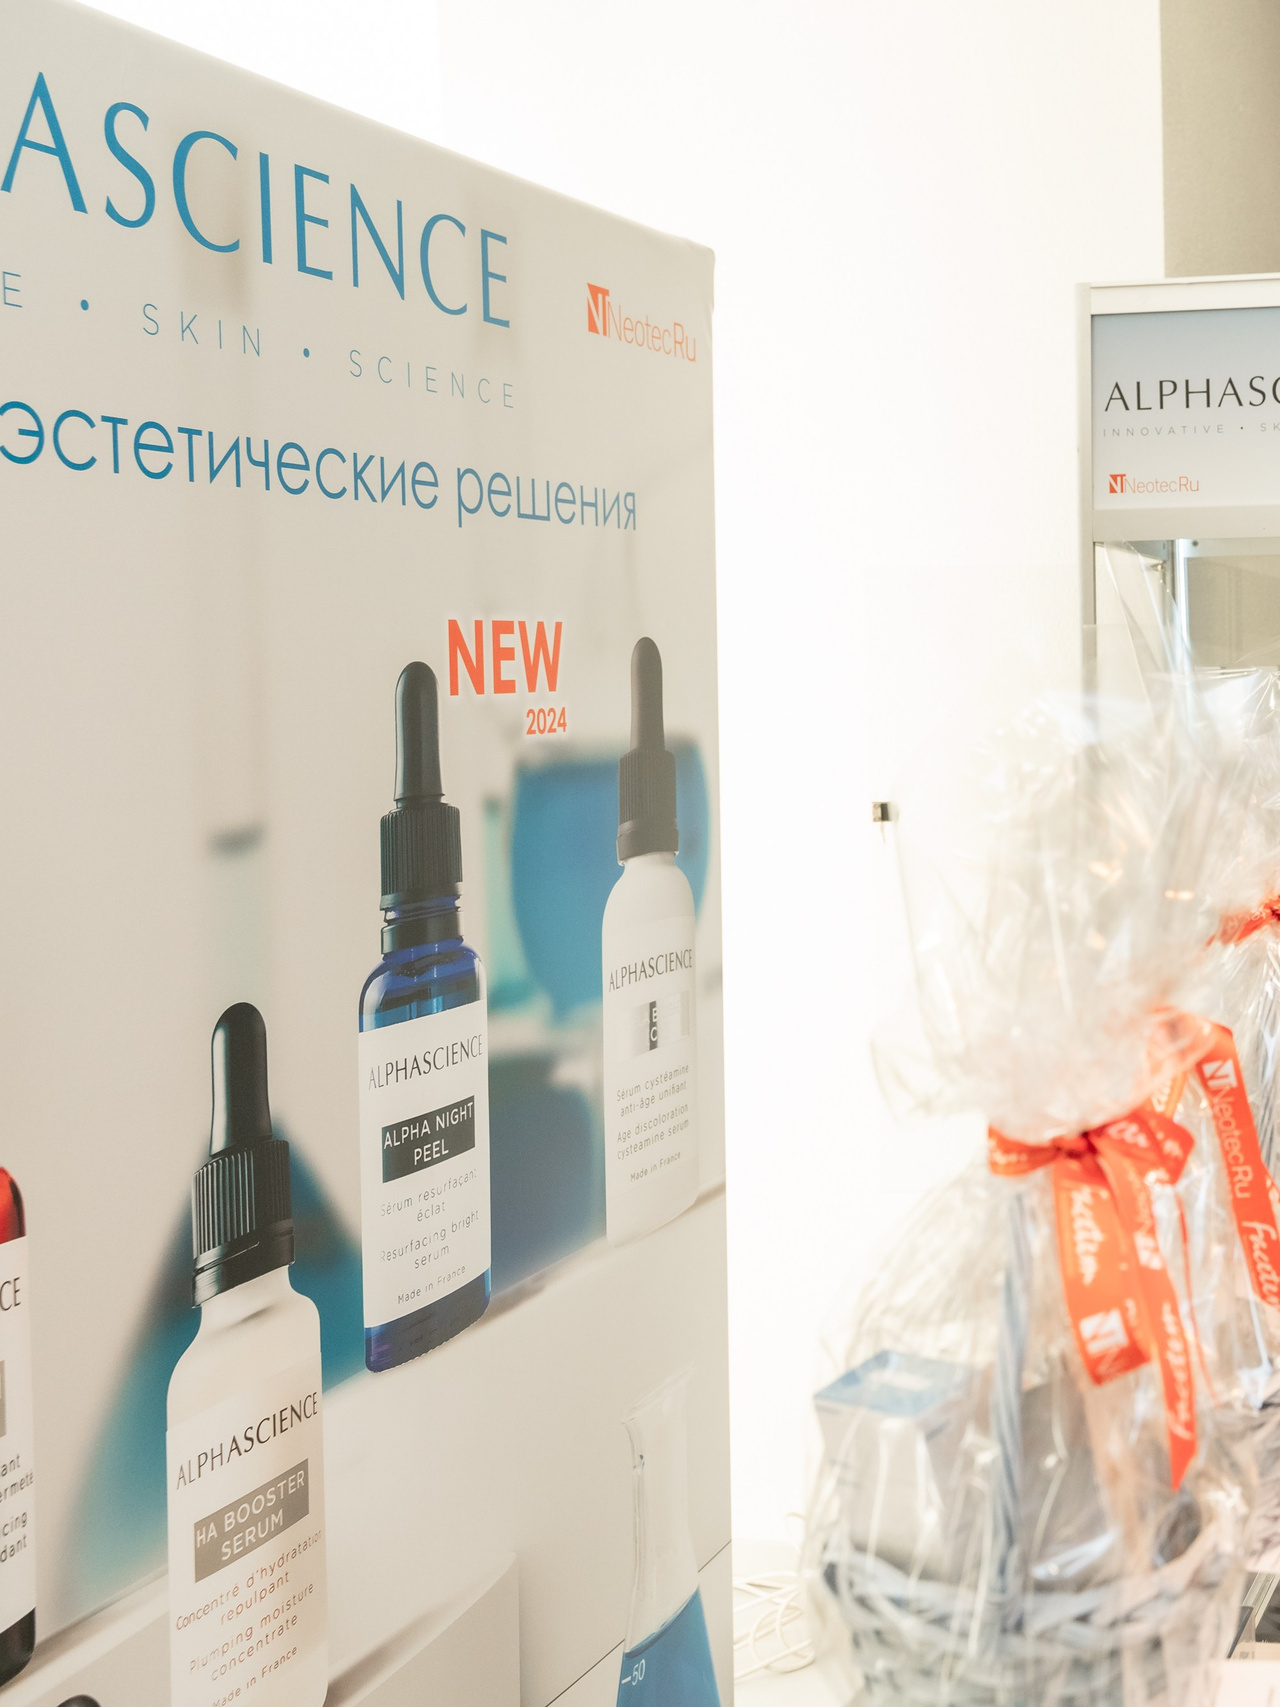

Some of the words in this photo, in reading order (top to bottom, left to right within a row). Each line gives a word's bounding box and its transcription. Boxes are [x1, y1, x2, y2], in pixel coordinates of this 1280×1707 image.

[0, 71, 510, 328] ASCIENCE
[142, 302, 262, 357] SKIN
[349, 349, 515, 409] SCIENCE
[1103, 423, 1225, 437] INNOVATIVE
[0, 401, 439, 509] эстетические
[457, 465, 637, 530] решения
[448, 619, 563, 696] NEW
[526, 707, 567, 735] 2024
[608, 948, 693, 993] ALPHASCIENCE
[369, 1034, 483, 1090] ALPHASCIENCE
[617, 1083, 641, 1102] Sérum
[644, 1064, 689, 1091] cystéamine
[383, 1120, 431, 1150] ALPHA
[436, 1101, 474, 1131] NIGHT
[617, 1126, 631, 1144] Age
[634, 1103, 689, 1137] discoloration
[617, 1131, 665, 1161] cysteamine
[668, 1118, 690, 1138] serum
[413, 1138, 449, 1165] PEEL
[630, 1167, 649, 1182] Made
[650, 1163, 657, 1173] in
[659, 1151, 681, 1169] France
[381, 1197, 413, 1217] Sérum
[417, 1201, 446, 1222] éclat
[381, 1228, 447, 1262] Resurfacing
[451, 1210, 479, 1233] bright
[414, 1244, 450, 1269] serum
[397, 1288, 421, 1305] Made
[425, 1281, 434, 1292] in
[438, 1265, 466, 1286] France
[176, 1391, 318, 1491] ALPHASCIENCE
[196, 1524, 217, 1549] HA
[224, 1469, 306, 1531] BOOSTER
[221, 1508, 284, 1562] SERUM
[176, 1582, 240, 1632] Concentré
[220, 1571, 290, 1626] repulpant
[189, 1624, 253, 1674] Plumping
[260, 1582, 315, 1631] moisture
[211, 1614, 299, 1682] concentrate
[246, 1674, 256, 1690] in
[261, 1645, 298, 1679] France
[631, 1659, 645, 1686] 50
